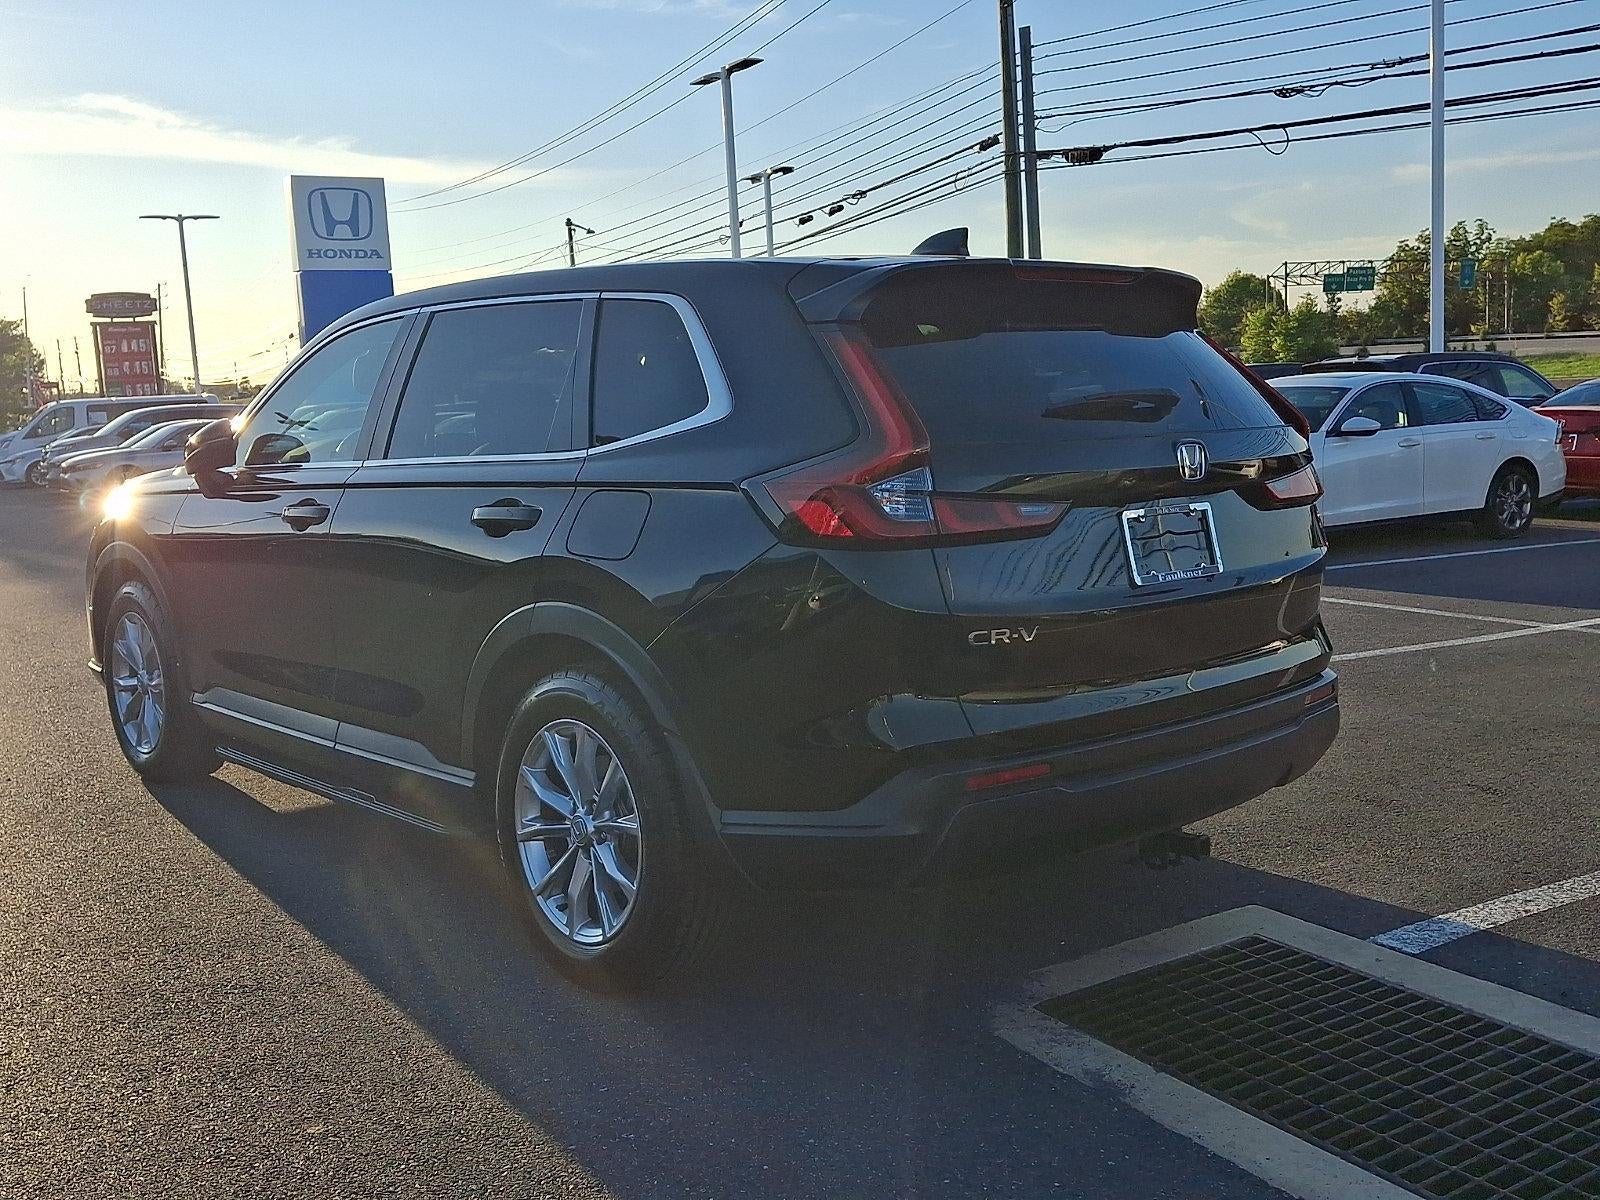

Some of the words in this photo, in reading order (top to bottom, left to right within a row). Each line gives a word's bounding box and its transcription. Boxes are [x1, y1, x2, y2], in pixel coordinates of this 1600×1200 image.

[306, 248, 384, 259] HONDA
[93, 300, 152, 310] SHEETZ
[1158, 569, 1203, 582] Faulkner
[968, 625, 1040, 645] CR-V
